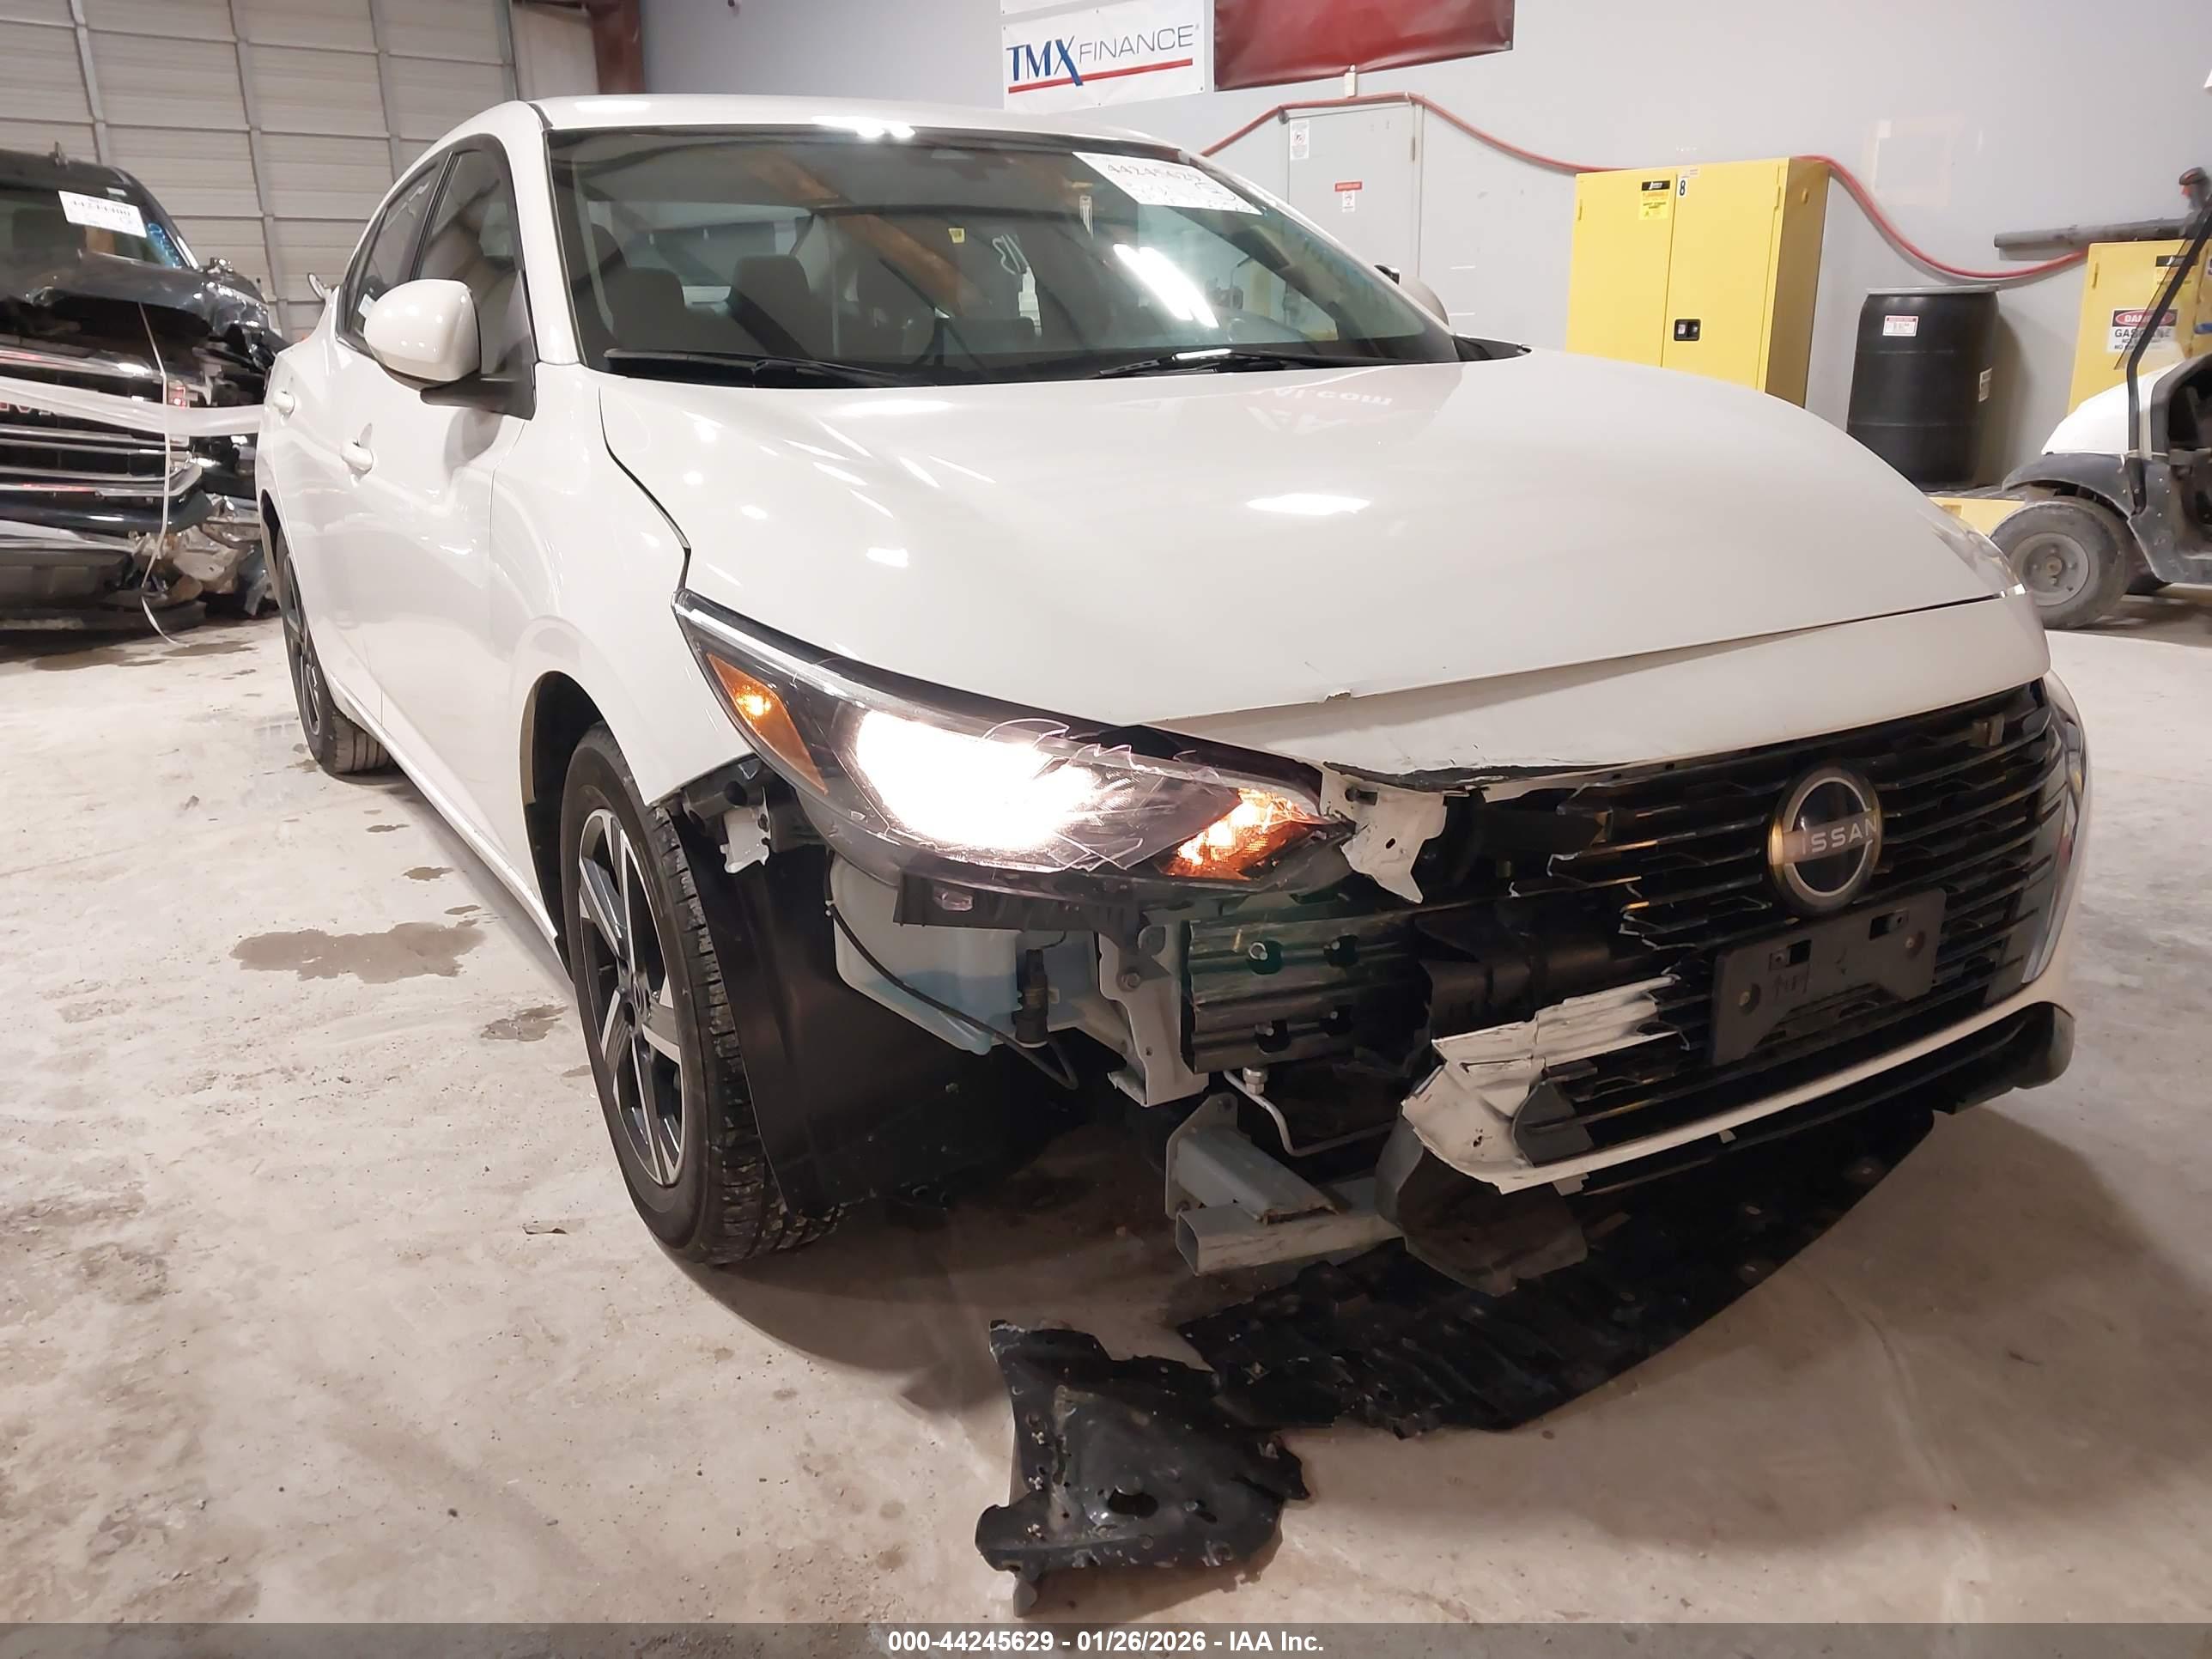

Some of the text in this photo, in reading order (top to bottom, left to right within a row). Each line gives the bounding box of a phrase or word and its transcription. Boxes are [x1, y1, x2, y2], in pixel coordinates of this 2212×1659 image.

[1006, 24, 1194, 87] TMX FINANCE
[1679, 179, 1686, 197] 8
[1800, 815, 1878, 855] ISSAN
